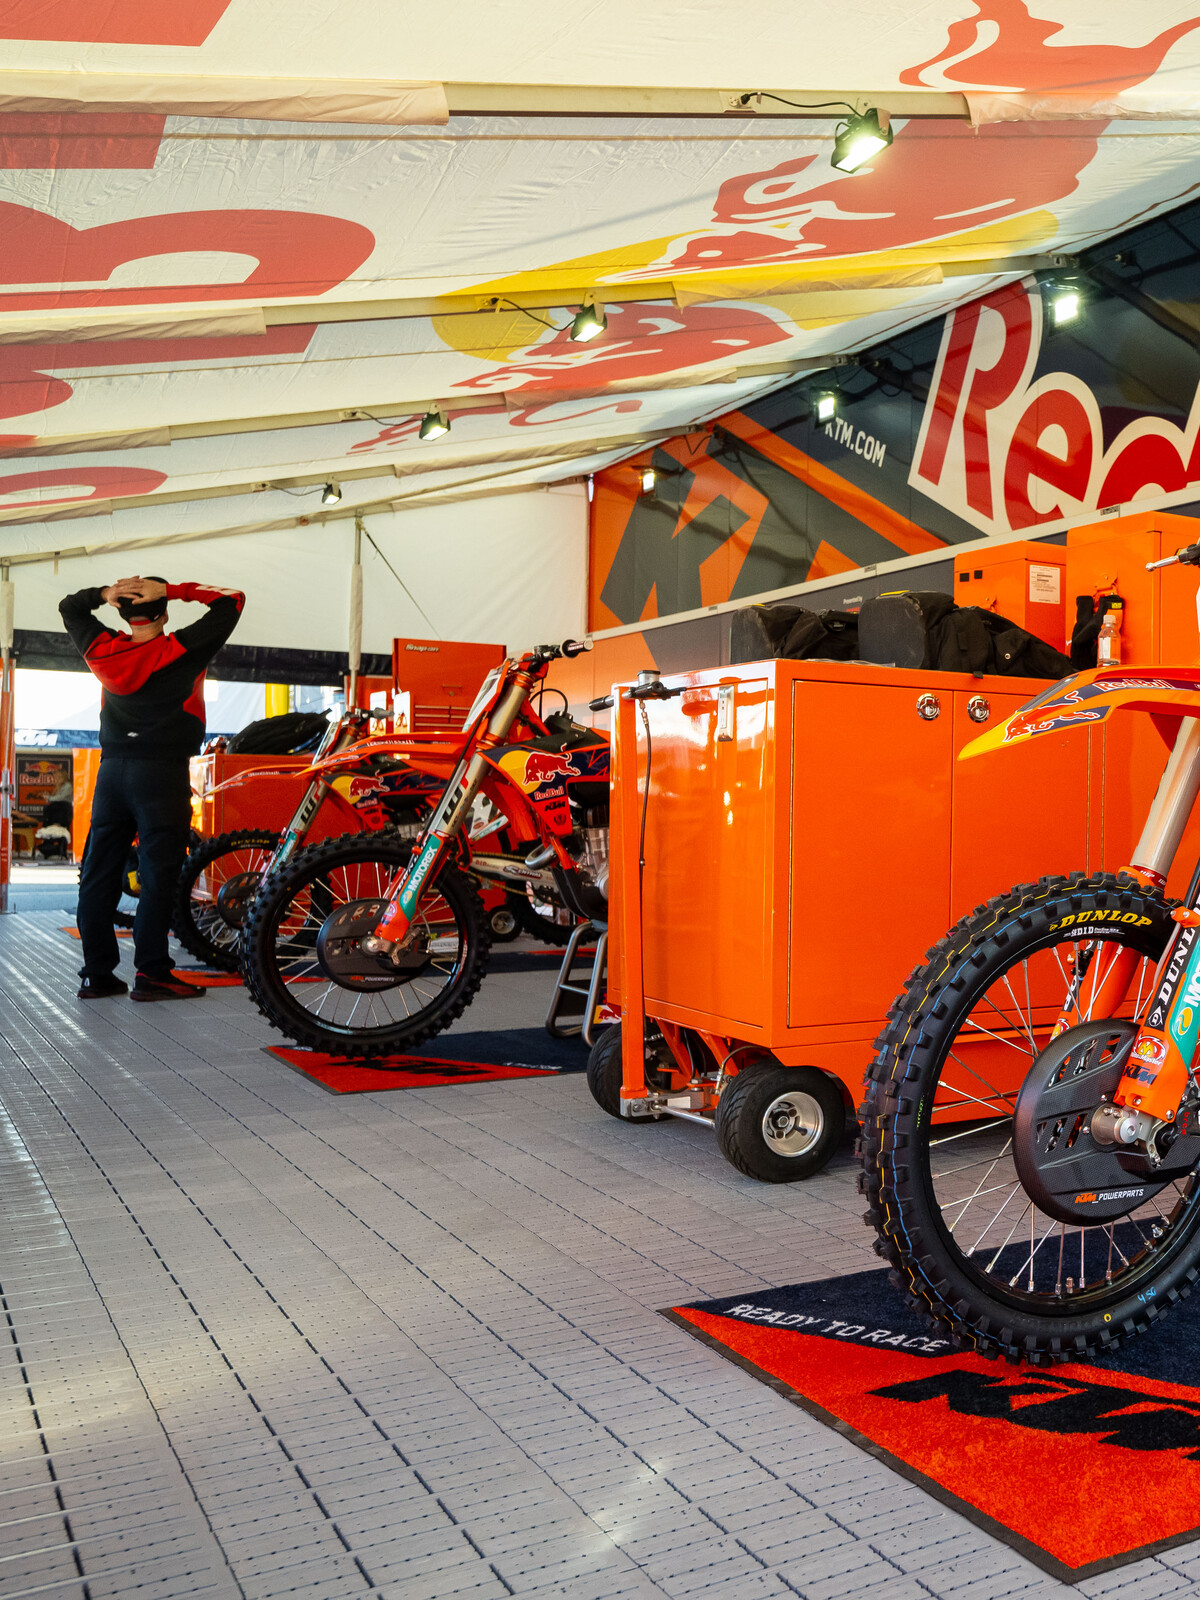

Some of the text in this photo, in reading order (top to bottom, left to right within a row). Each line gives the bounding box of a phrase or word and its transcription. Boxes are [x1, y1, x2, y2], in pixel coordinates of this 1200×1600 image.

[825, 417, 887, 467] KTM.COM
[1091, 678, 1177, 692] Red Bull
[407, 846, 438, 892] MOTOREX
[1057, 909, 1153, 929] DUNLOP
[1123, 1064, 1158, 1085] KTM
[723, 1303, 950, 1352] READY TO RACE
